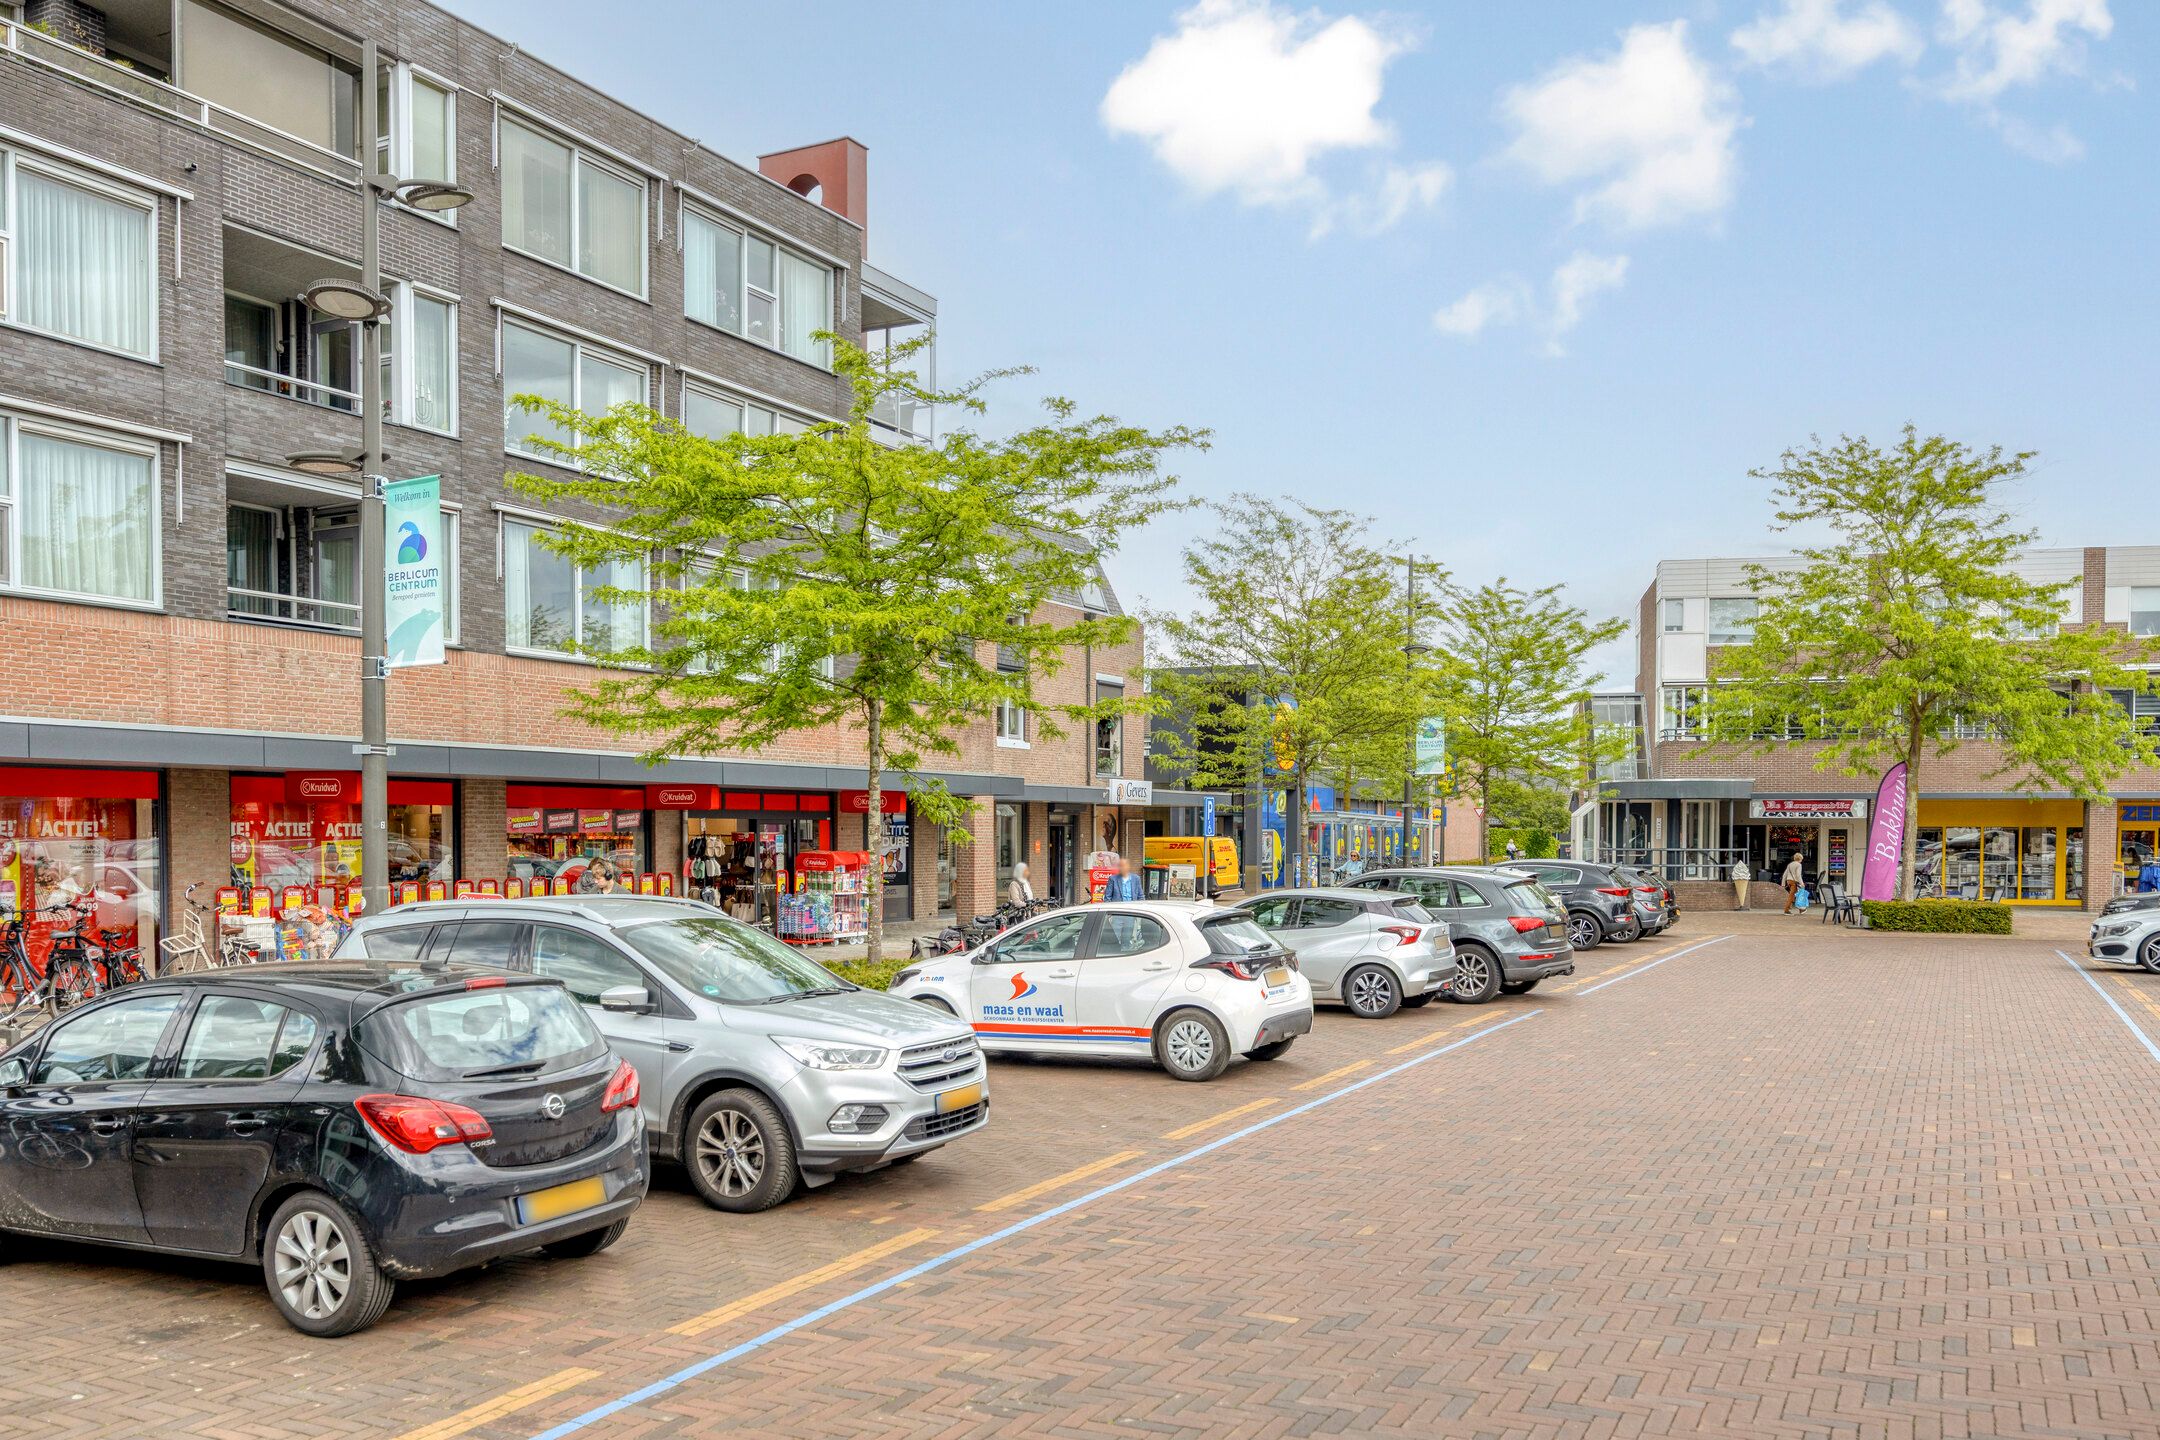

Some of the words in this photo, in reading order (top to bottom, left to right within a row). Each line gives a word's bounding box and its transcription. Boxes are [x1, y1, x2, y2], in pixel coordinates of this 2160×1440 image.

[394, 491, 421, 503] Welkom
[422, 489, 430, 499] in
[388, 568, 438, 582] BERLICUM
[389, 578, 437, 592] CENTRUM
[310, 782, 338, 792] Kruidvat
[1126, 782, 1147, 798] Gevers
[668, 792, 694, 801] Kruidvat
[1207, 800, 1213, 820] P
[1874, 771, 1907, 863] Bakhuus
[41, 821, 99, 837] ACTIE!
[265, 822, 312, 837] ACTIE!
[1168, 842, 1194, 850] DHL
[983, 1005, 1014, 1016] maas
[1017, 1006, 1032, 1016] en
[1035, 1005, 1064, 1017] waal
[470, 1138, 497, 1149] CORSA
